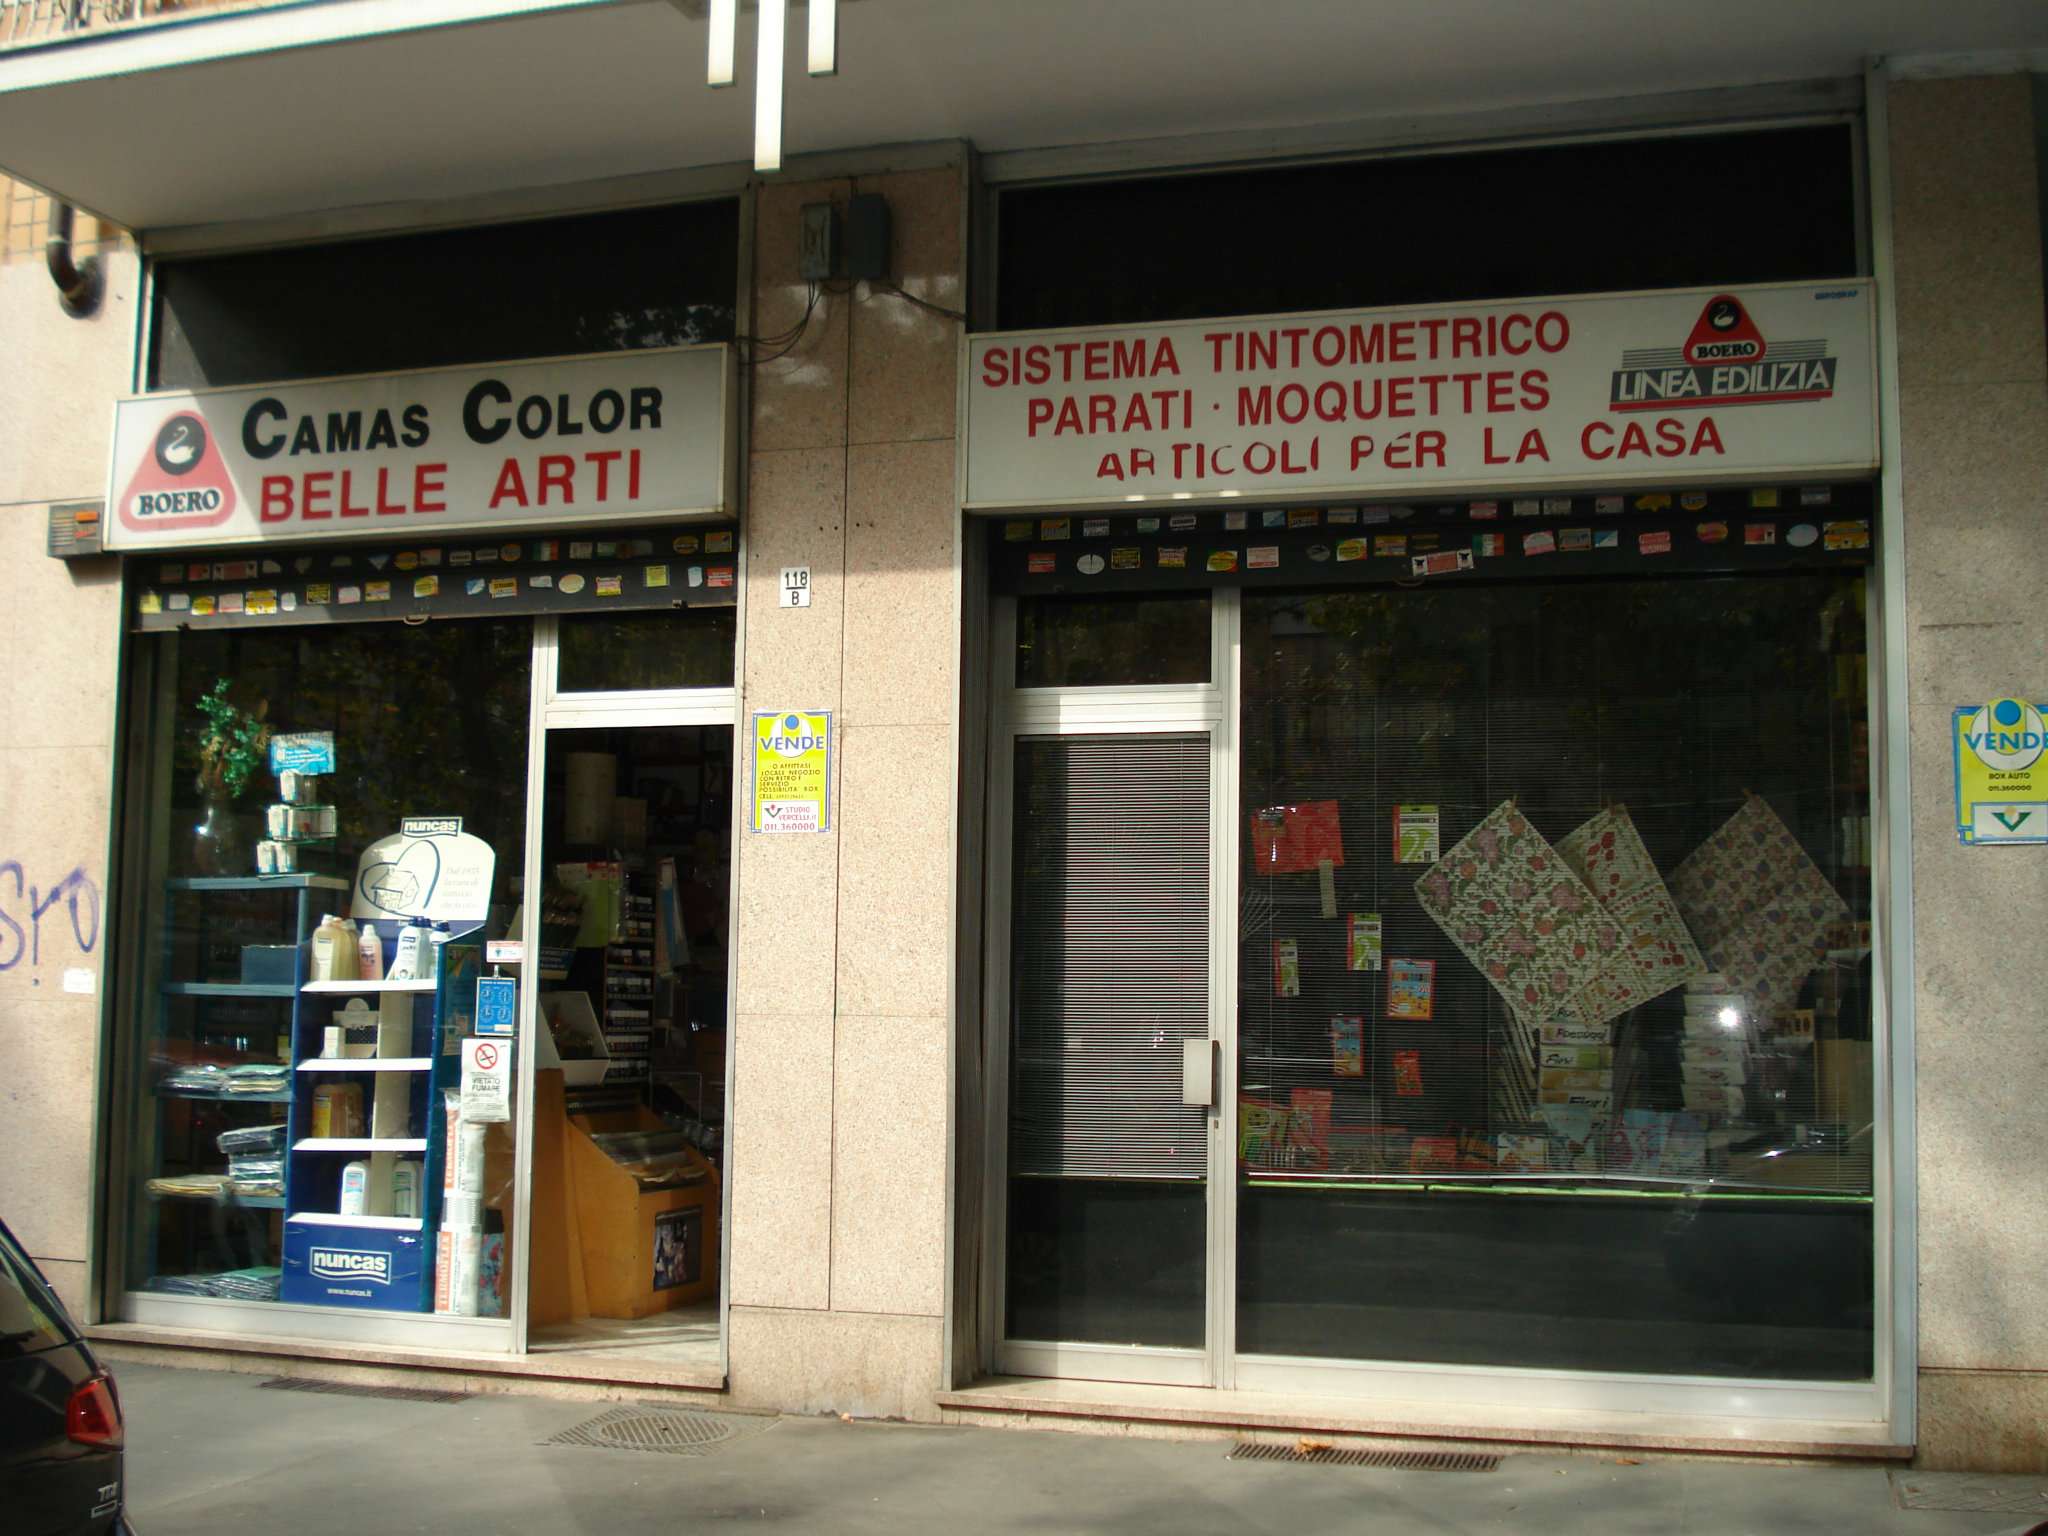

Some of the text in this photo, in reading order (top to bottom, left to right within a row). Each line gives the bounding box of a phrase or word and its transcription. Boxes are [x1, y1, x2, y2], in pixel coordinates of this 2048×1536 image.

[982, 311, 1570, 388] SISTEMA TINTOMETRICO
[1697, 342, 1755, 358] BOERO
[1619, 361, 1831, 400] LINEA EDILIZIA
[1028, 370, 1550, 437] PARATI MOQUETTES
[242, 379, 663, 459] CAMAS COLOR
[1097, 417, 1725, 481] ARTICOLI PER LA CASA
[260, 449, 641, 523] BELLE ARTI
[138, 489, 220, 516] BOERO
[785, 571, 808, 586] 118
[760, 736, 824, 750] VENDE
[2008, 772, 2031, 780] AUTO
[404, 819, 457, 832] nuncas
[764, 823, 815, 831] 011.360000
[314, 1252, 387, 1271] nuncas
